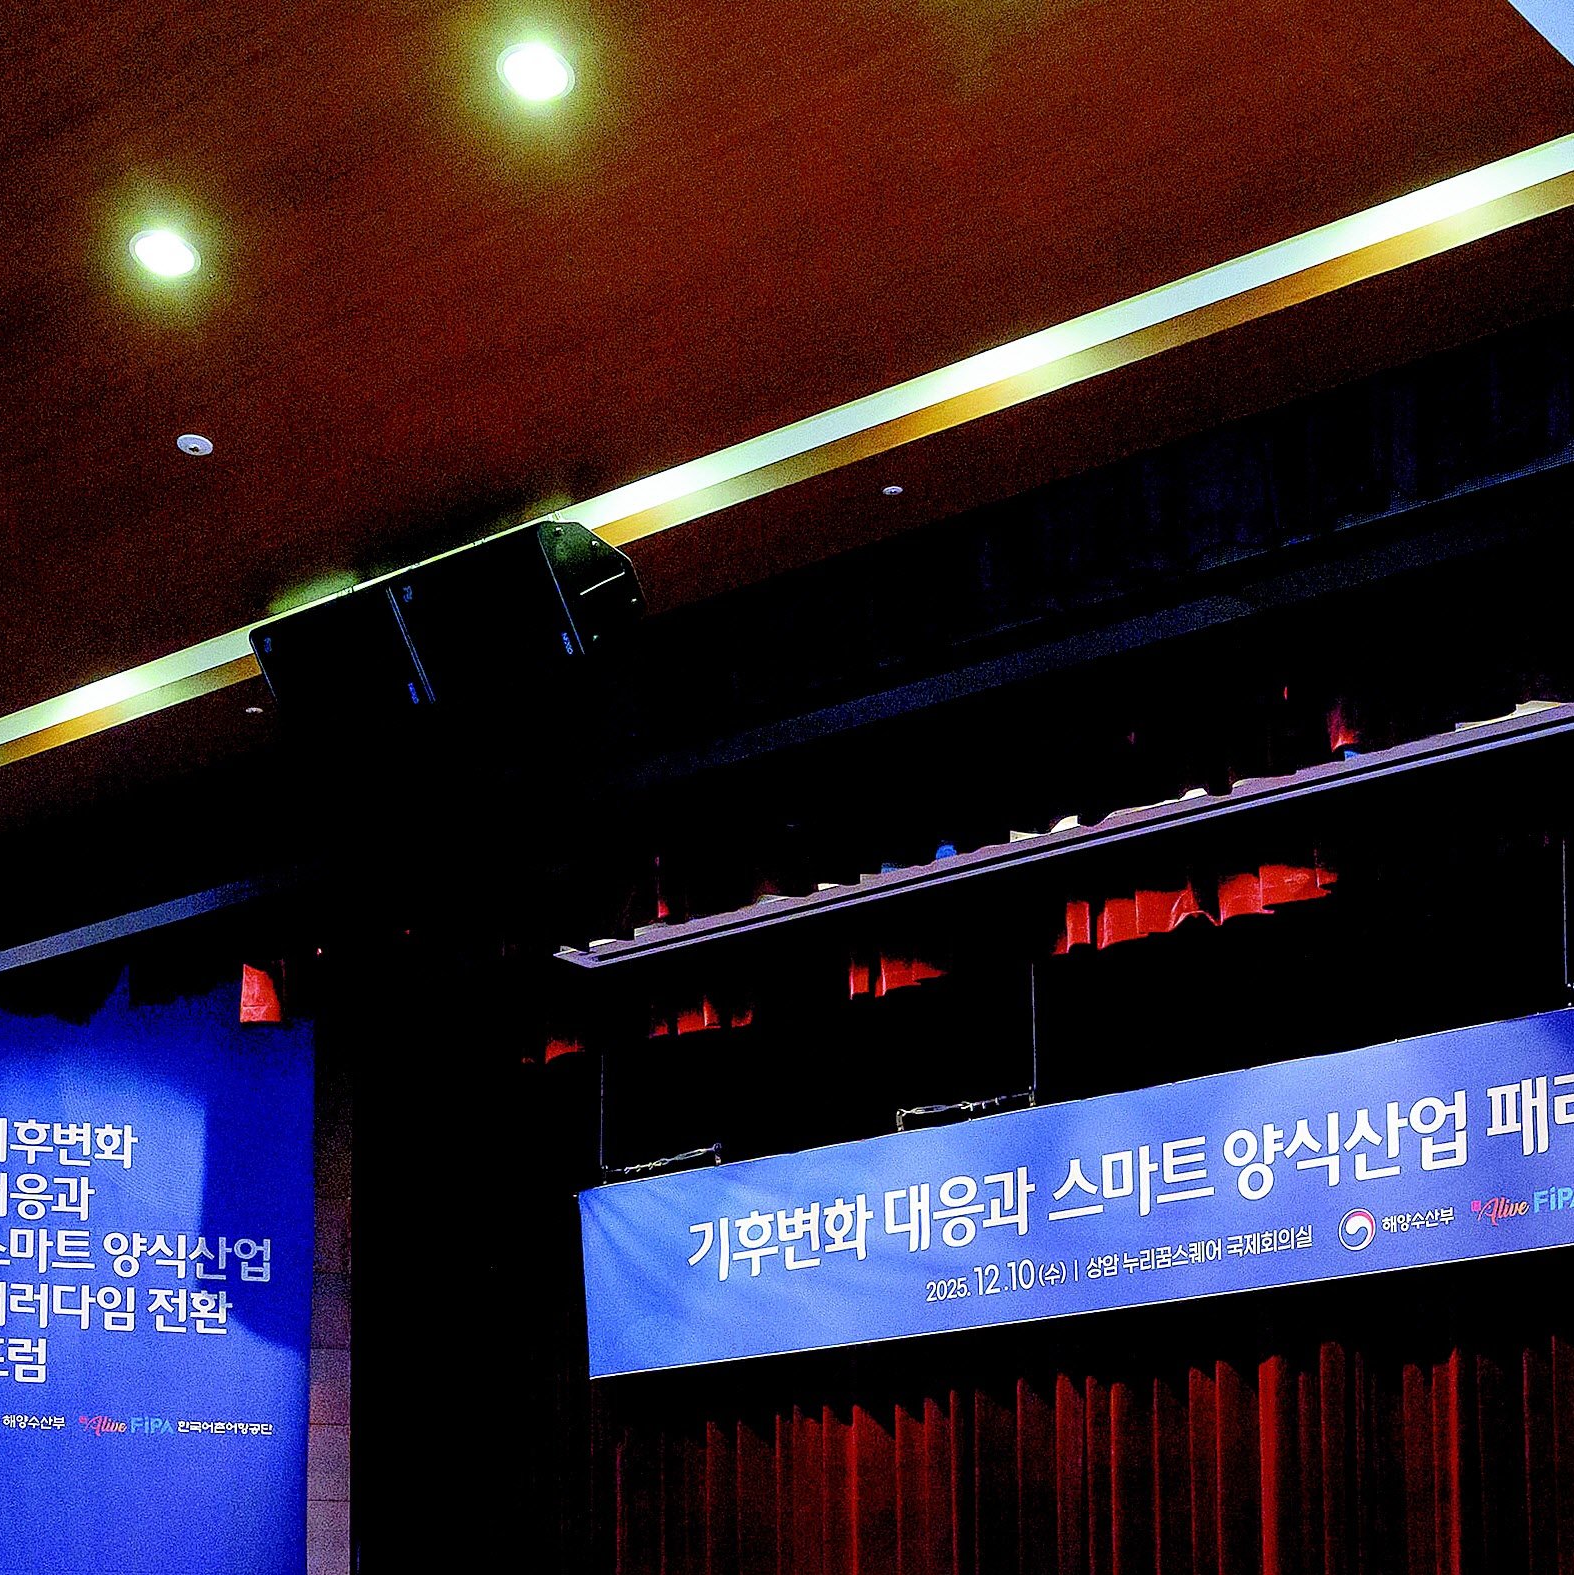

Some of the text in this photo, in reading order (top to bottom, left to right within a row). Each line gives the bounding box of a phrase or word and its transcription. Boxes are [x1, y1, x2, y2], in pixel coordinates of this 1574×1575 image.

[687, 1199, 874, 1282] 기후변화
[883, 1167, 1038, 1251] 대응과
[1046, 1136, 1216, 1222] 스마트
[1222, 1090, 1469, 1200] 양식산업
[1381, 1207, 1456, 1232] 해양수산부
[103, 1231, 272, 1283] 양식산업
[1085, 1255, 1120, 1278] 상암
[1122, 1239, 1223, 1274] 누리꿈스퀘어
[1226, 1224, 1313, 1256] 국제회의실
[148, 1287, 233, 1335] 전환
[2, 1414, 66, 1430] 해양수산부
[177, 1420, 274, 1436] 한국어촌어항공단
